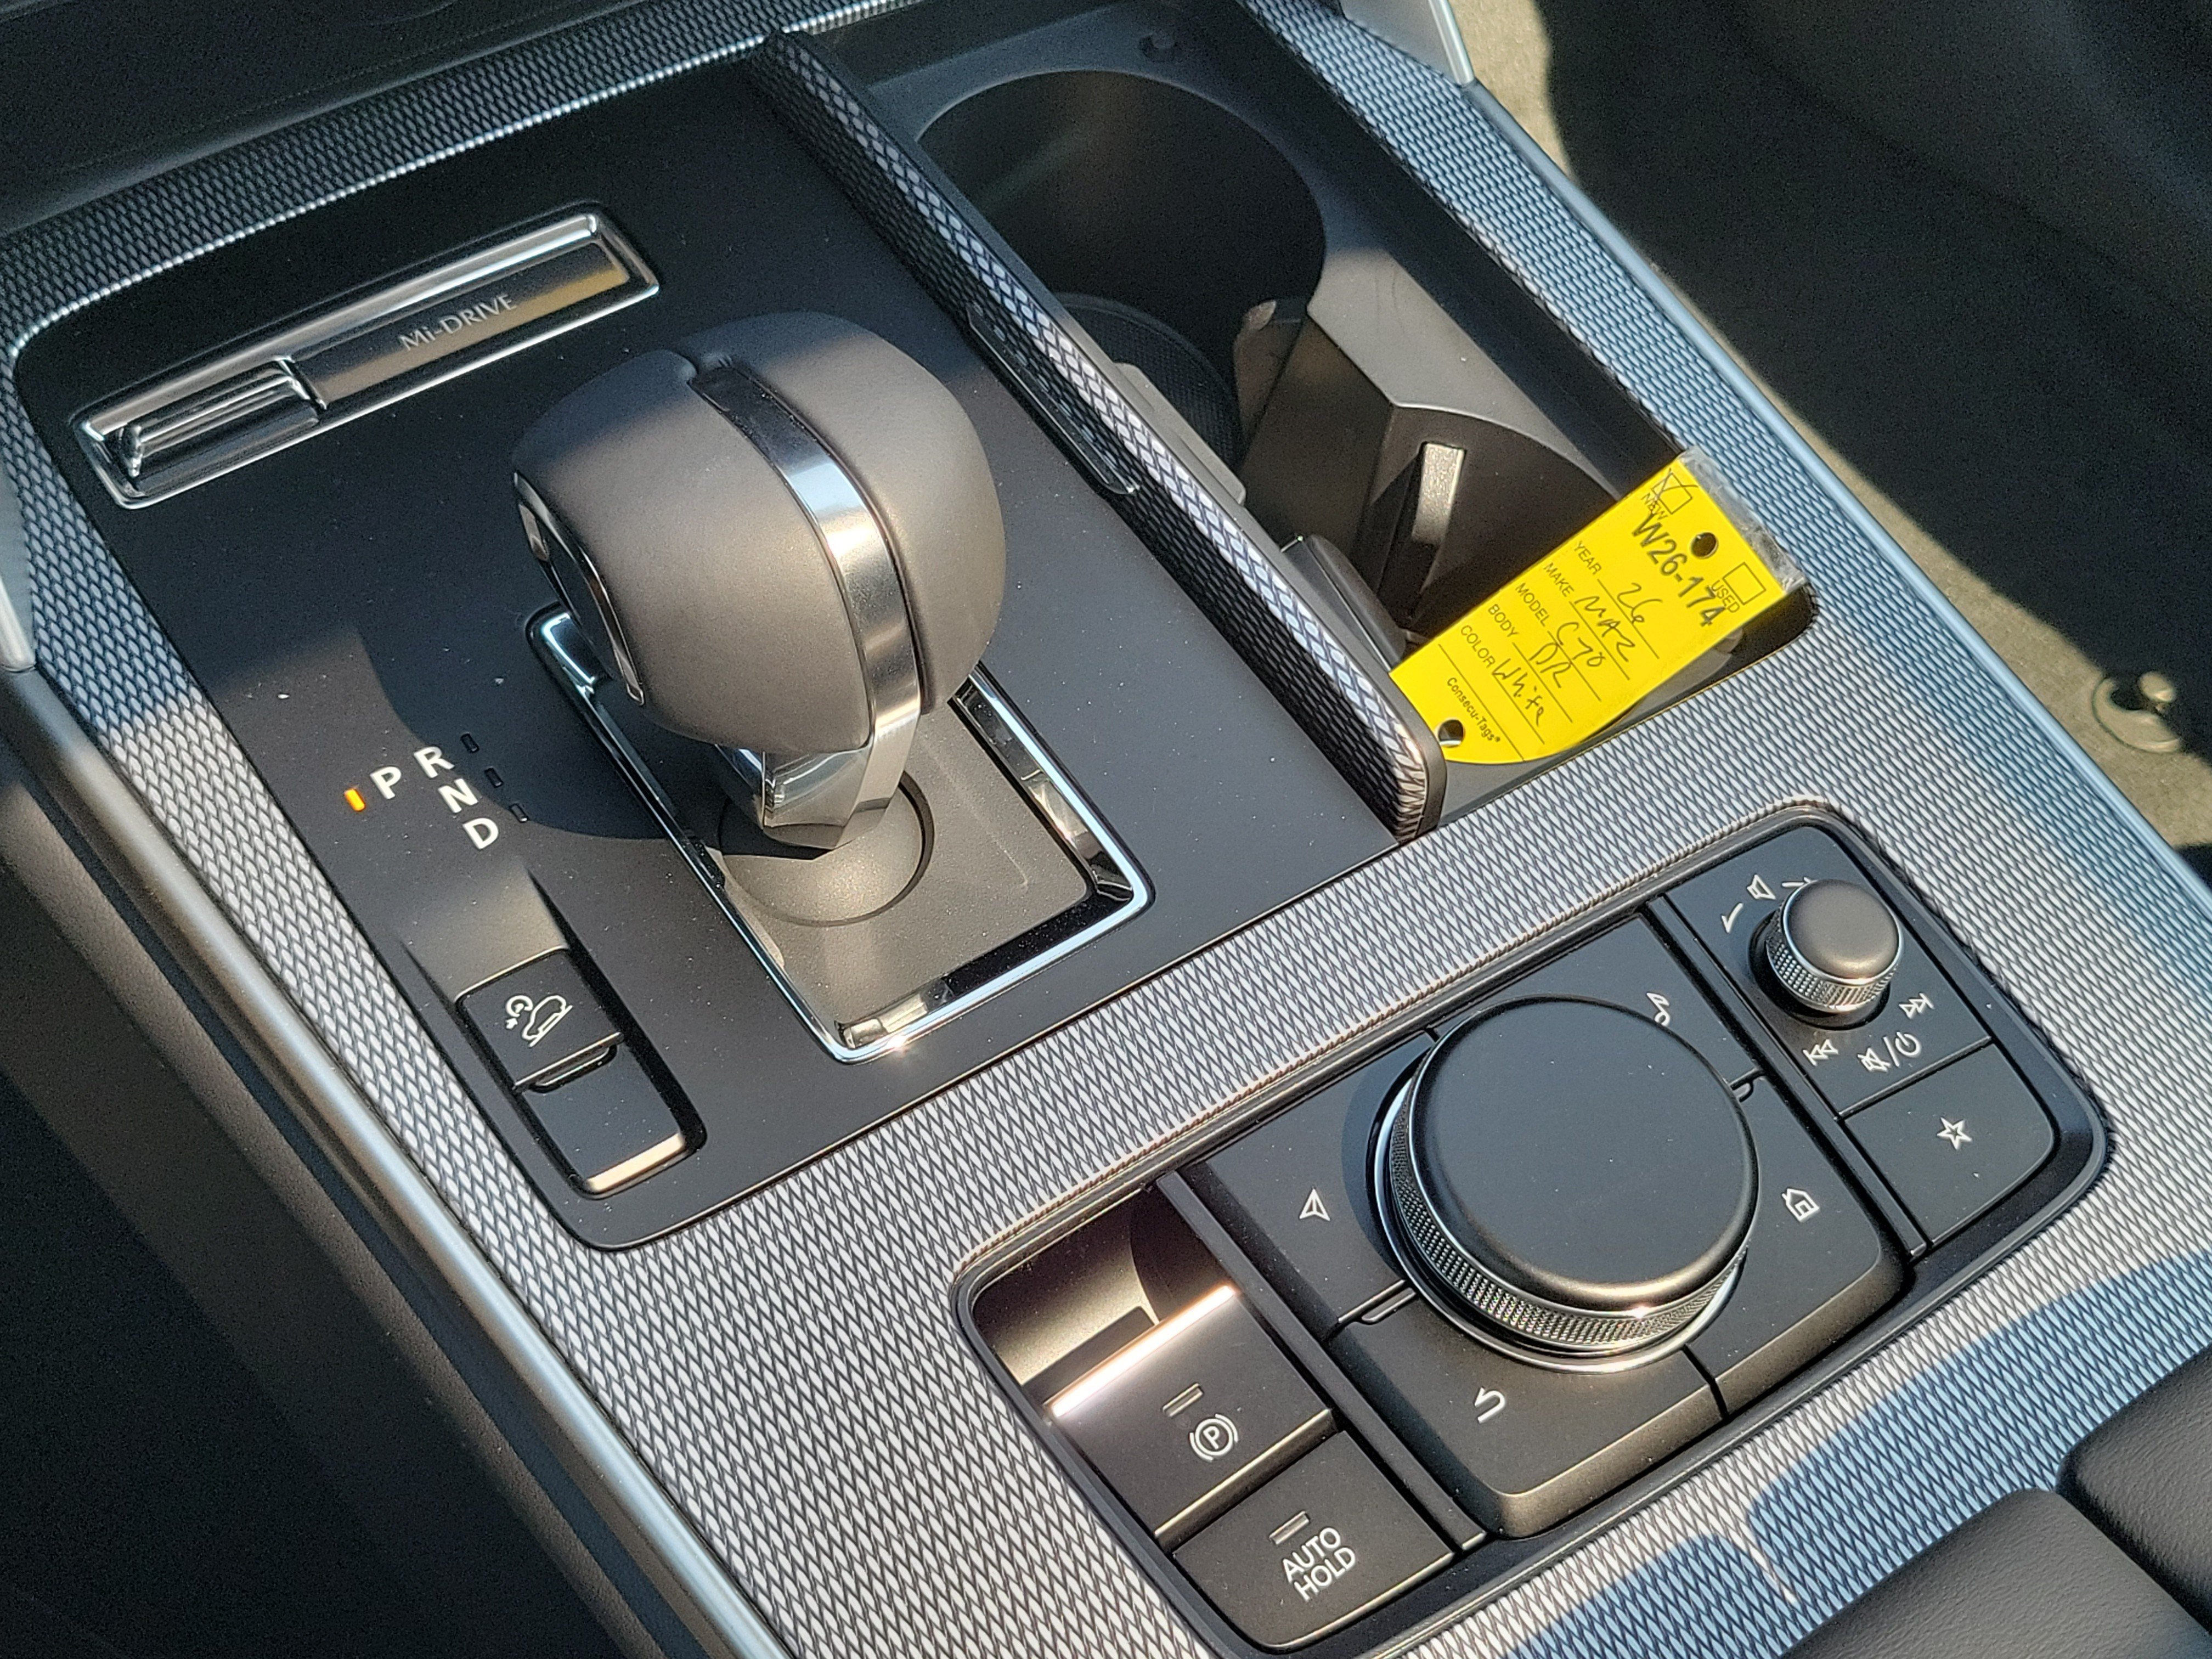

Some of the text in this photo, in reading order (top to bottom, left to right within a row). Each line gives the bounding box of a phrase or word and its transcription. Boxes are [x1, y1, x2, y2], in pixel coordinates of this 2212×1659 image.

[397, 294, 517, 352] Mi-DRIVE
[1641, 493, 1668, 520] NEW
[1573, 540, 1602, 575] YEAR
[1632, 510, 1727, 627] W26-174
[1543, 562, 1575, 597] MAKE
[1712, 580, 1740, 613] USED
[1488, 603, 1519, 637] BODY
[1515, 583, 1549, 627] MODEL
[1617, 583, 1663, 624] 26
[1460, 625, 1496, 668] COLOR
[414, 746, 455, 778] R
[370, 766, 402, 799] P
[438, 778, 478, 813] N
[462, 817, 499, 850] D
[1282, 1527, 1341, 1583] AUTO
[1294, 1547, 1356, 1601] HOLD
